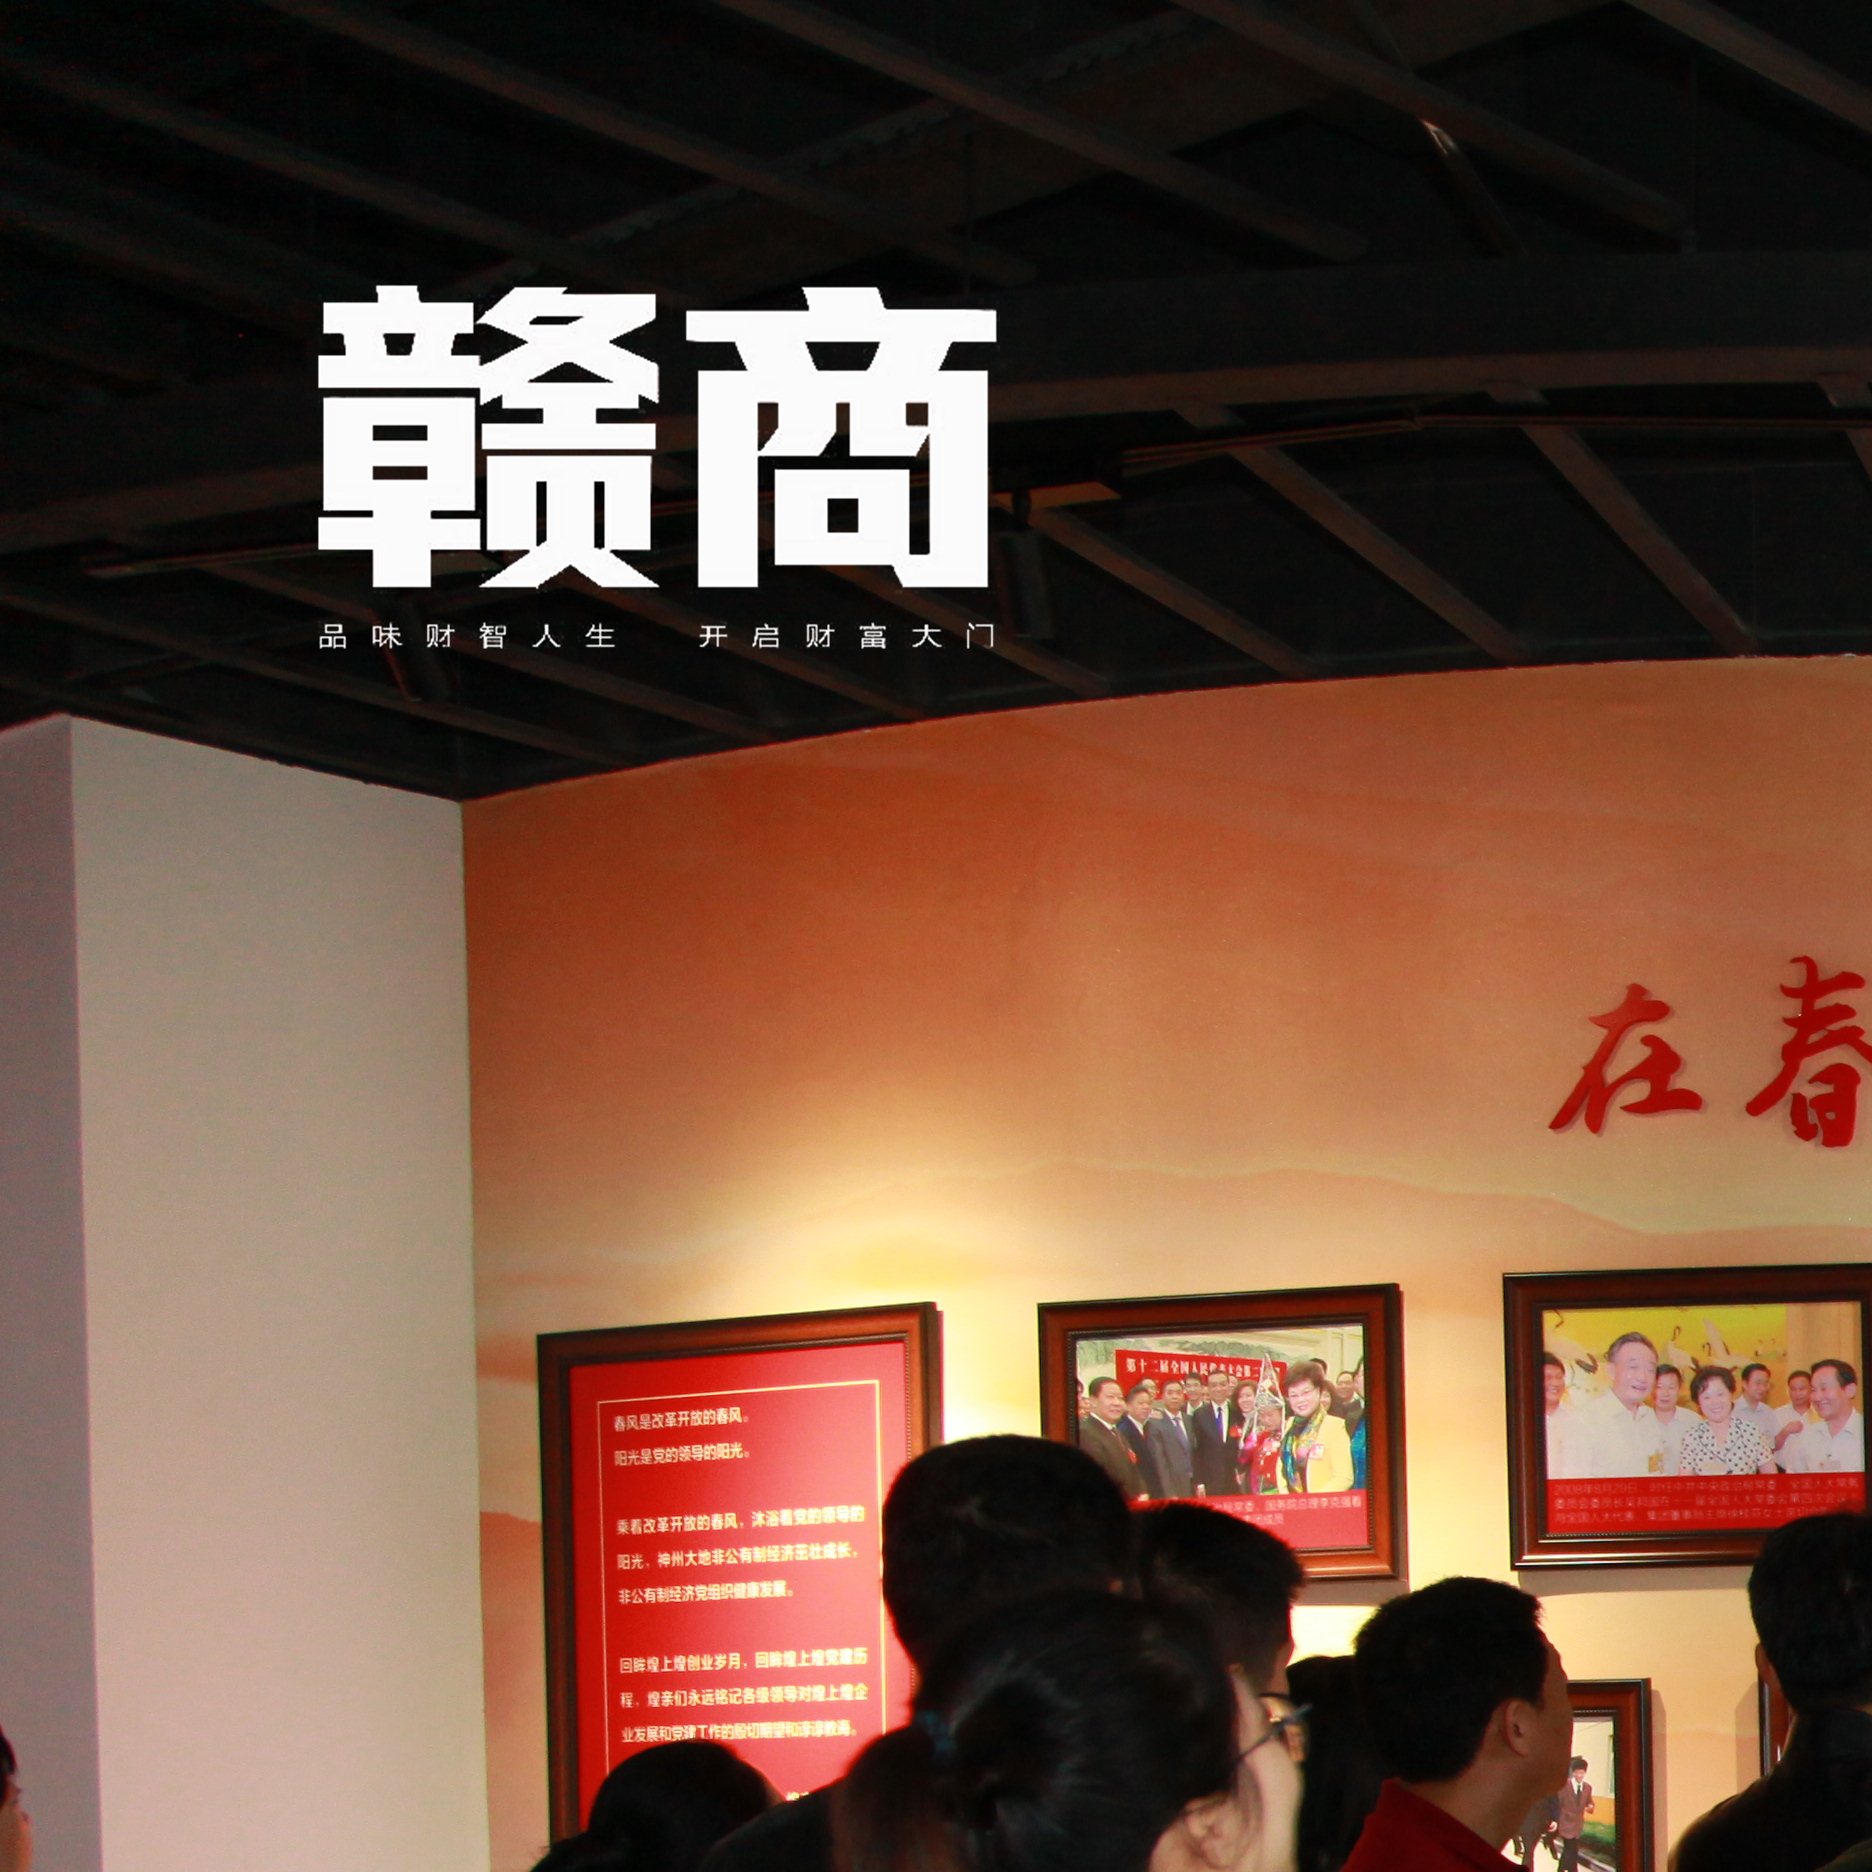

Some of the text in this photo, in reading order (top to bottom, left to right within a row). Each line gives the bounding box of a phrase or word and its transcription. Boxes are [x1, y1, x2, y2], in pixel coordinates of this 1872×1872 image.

[614, 1406, 750, 1433] 春风是改革开放的春风。
[613, 1441, 751, 1467] 阳光是党的领导的阳光。
